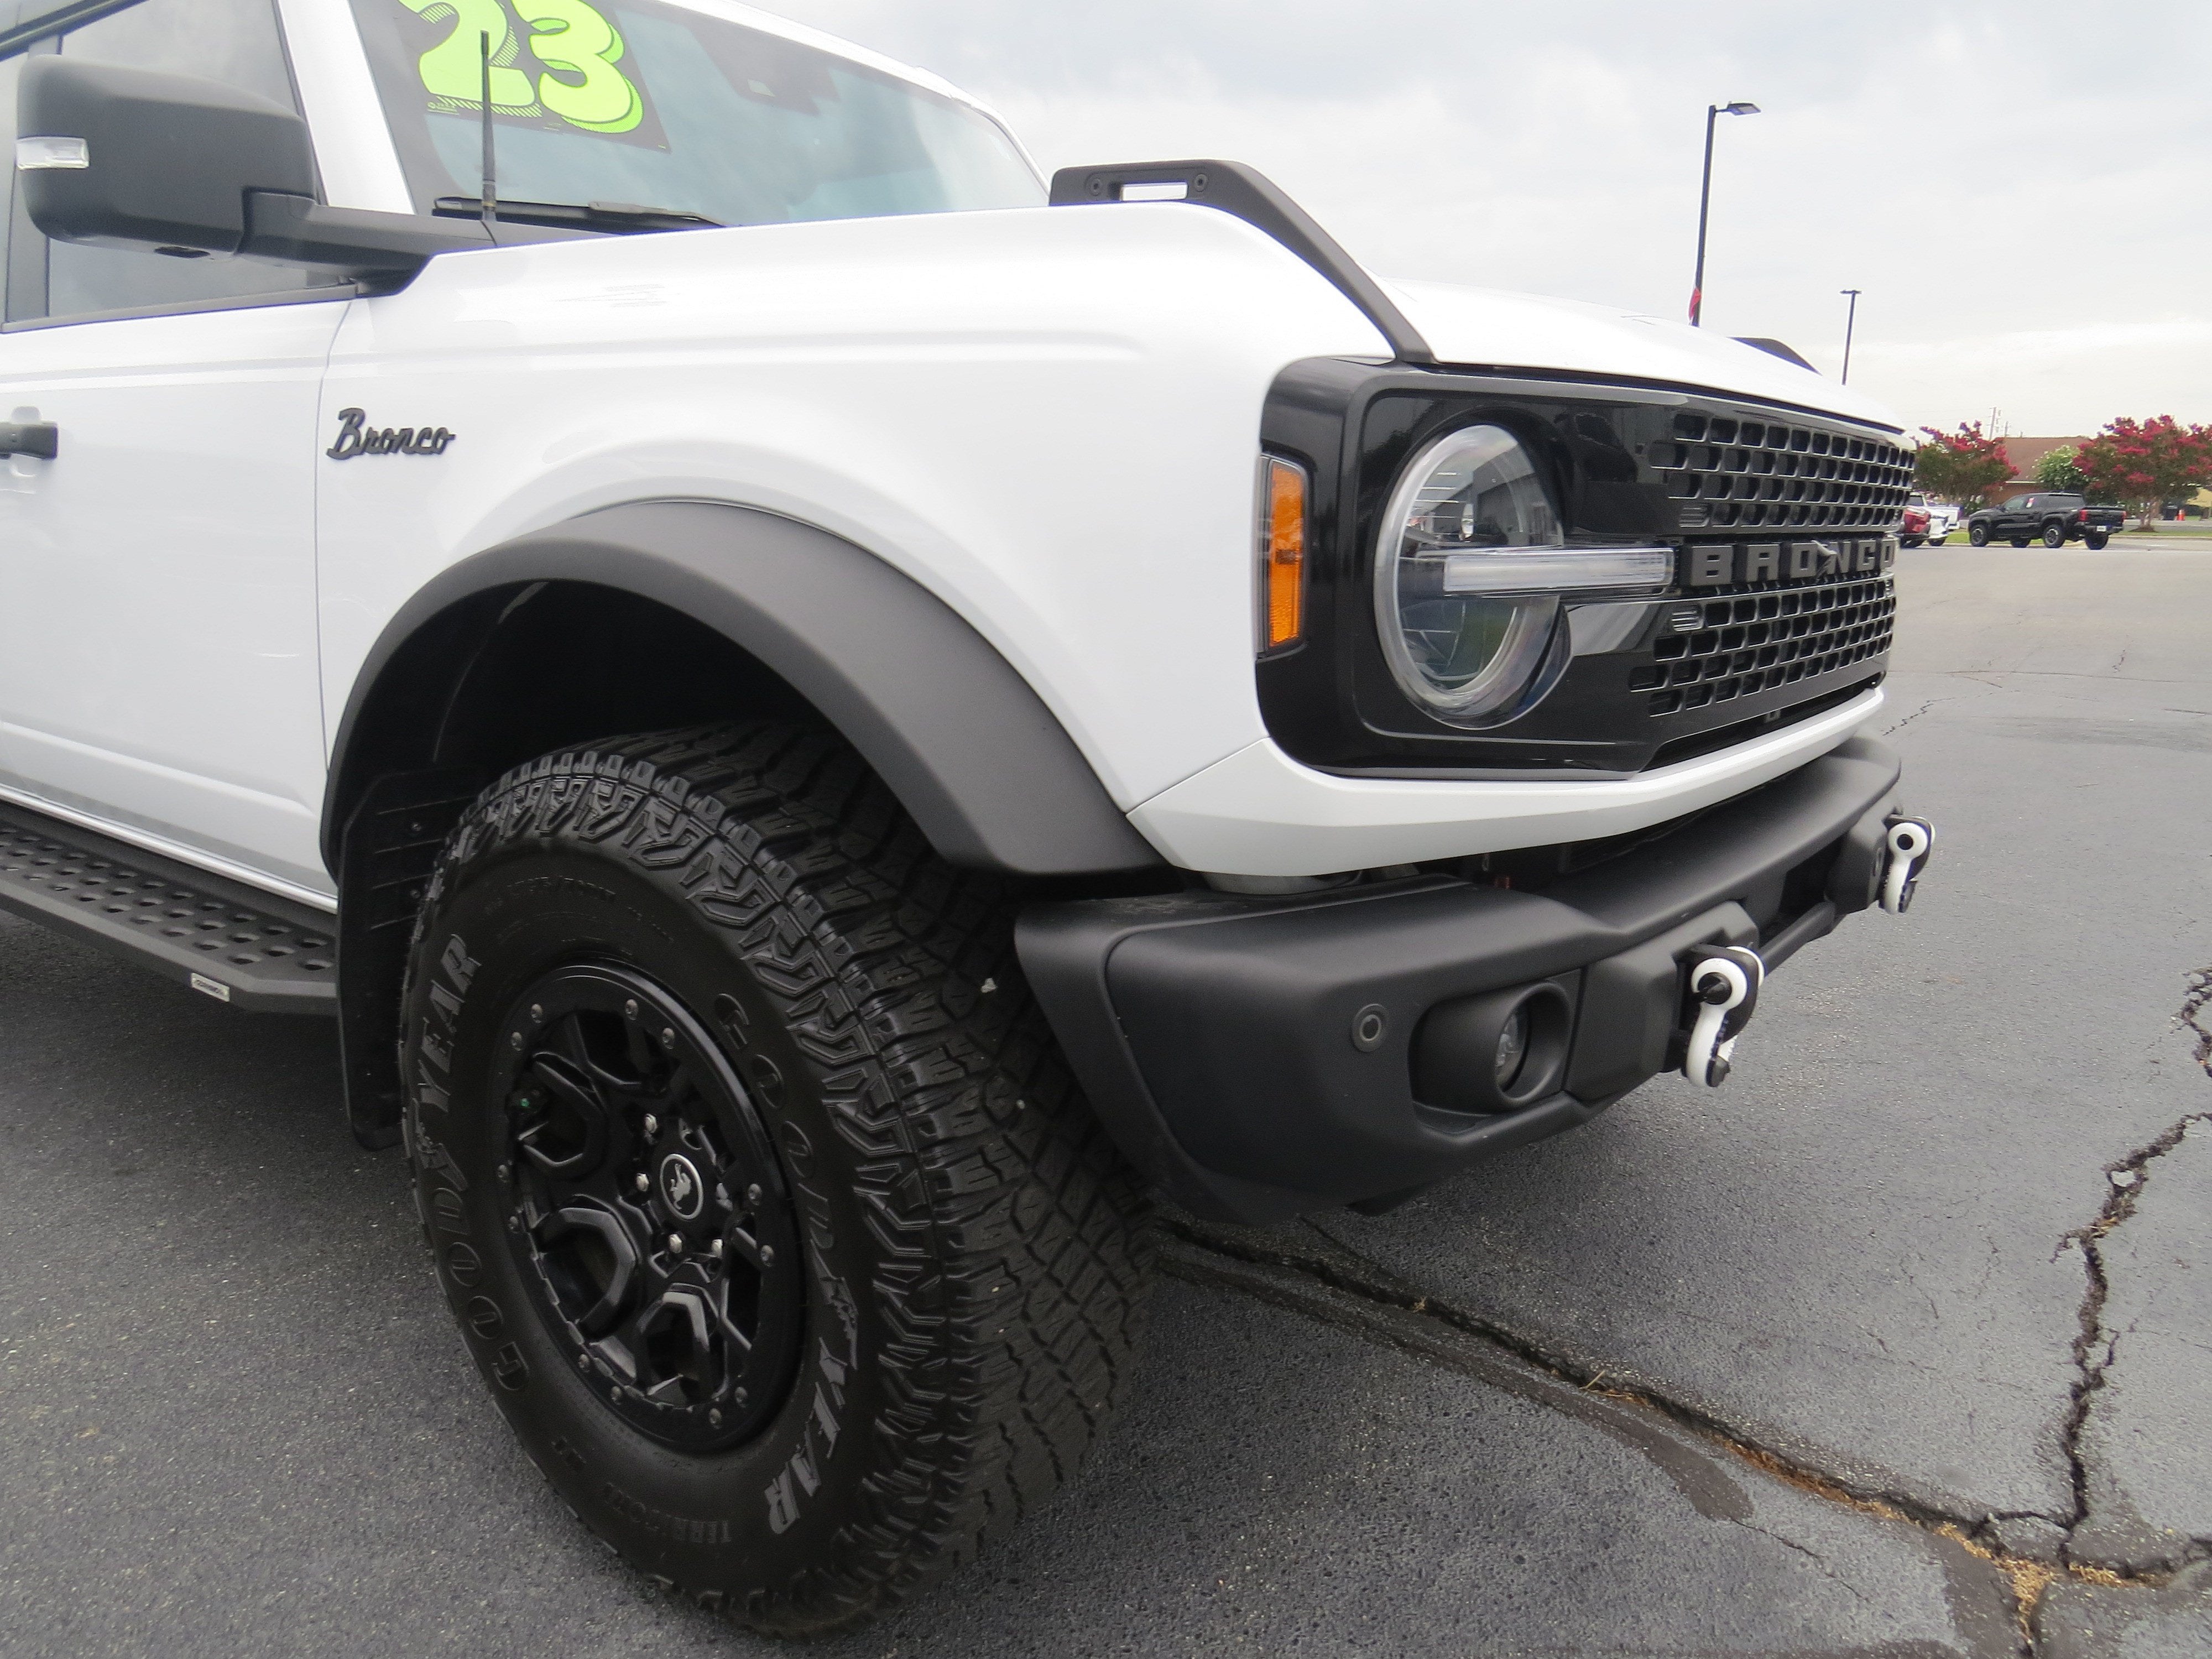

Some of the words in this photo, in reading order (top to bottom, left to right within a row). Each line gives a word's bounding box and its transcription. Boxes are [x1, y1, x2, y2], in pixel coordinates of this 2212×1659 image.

[398, 0, 644, 133] 23
[326, 407, 456, 460] Bronco
[1691, 538, 1897, 587] BRONCO
